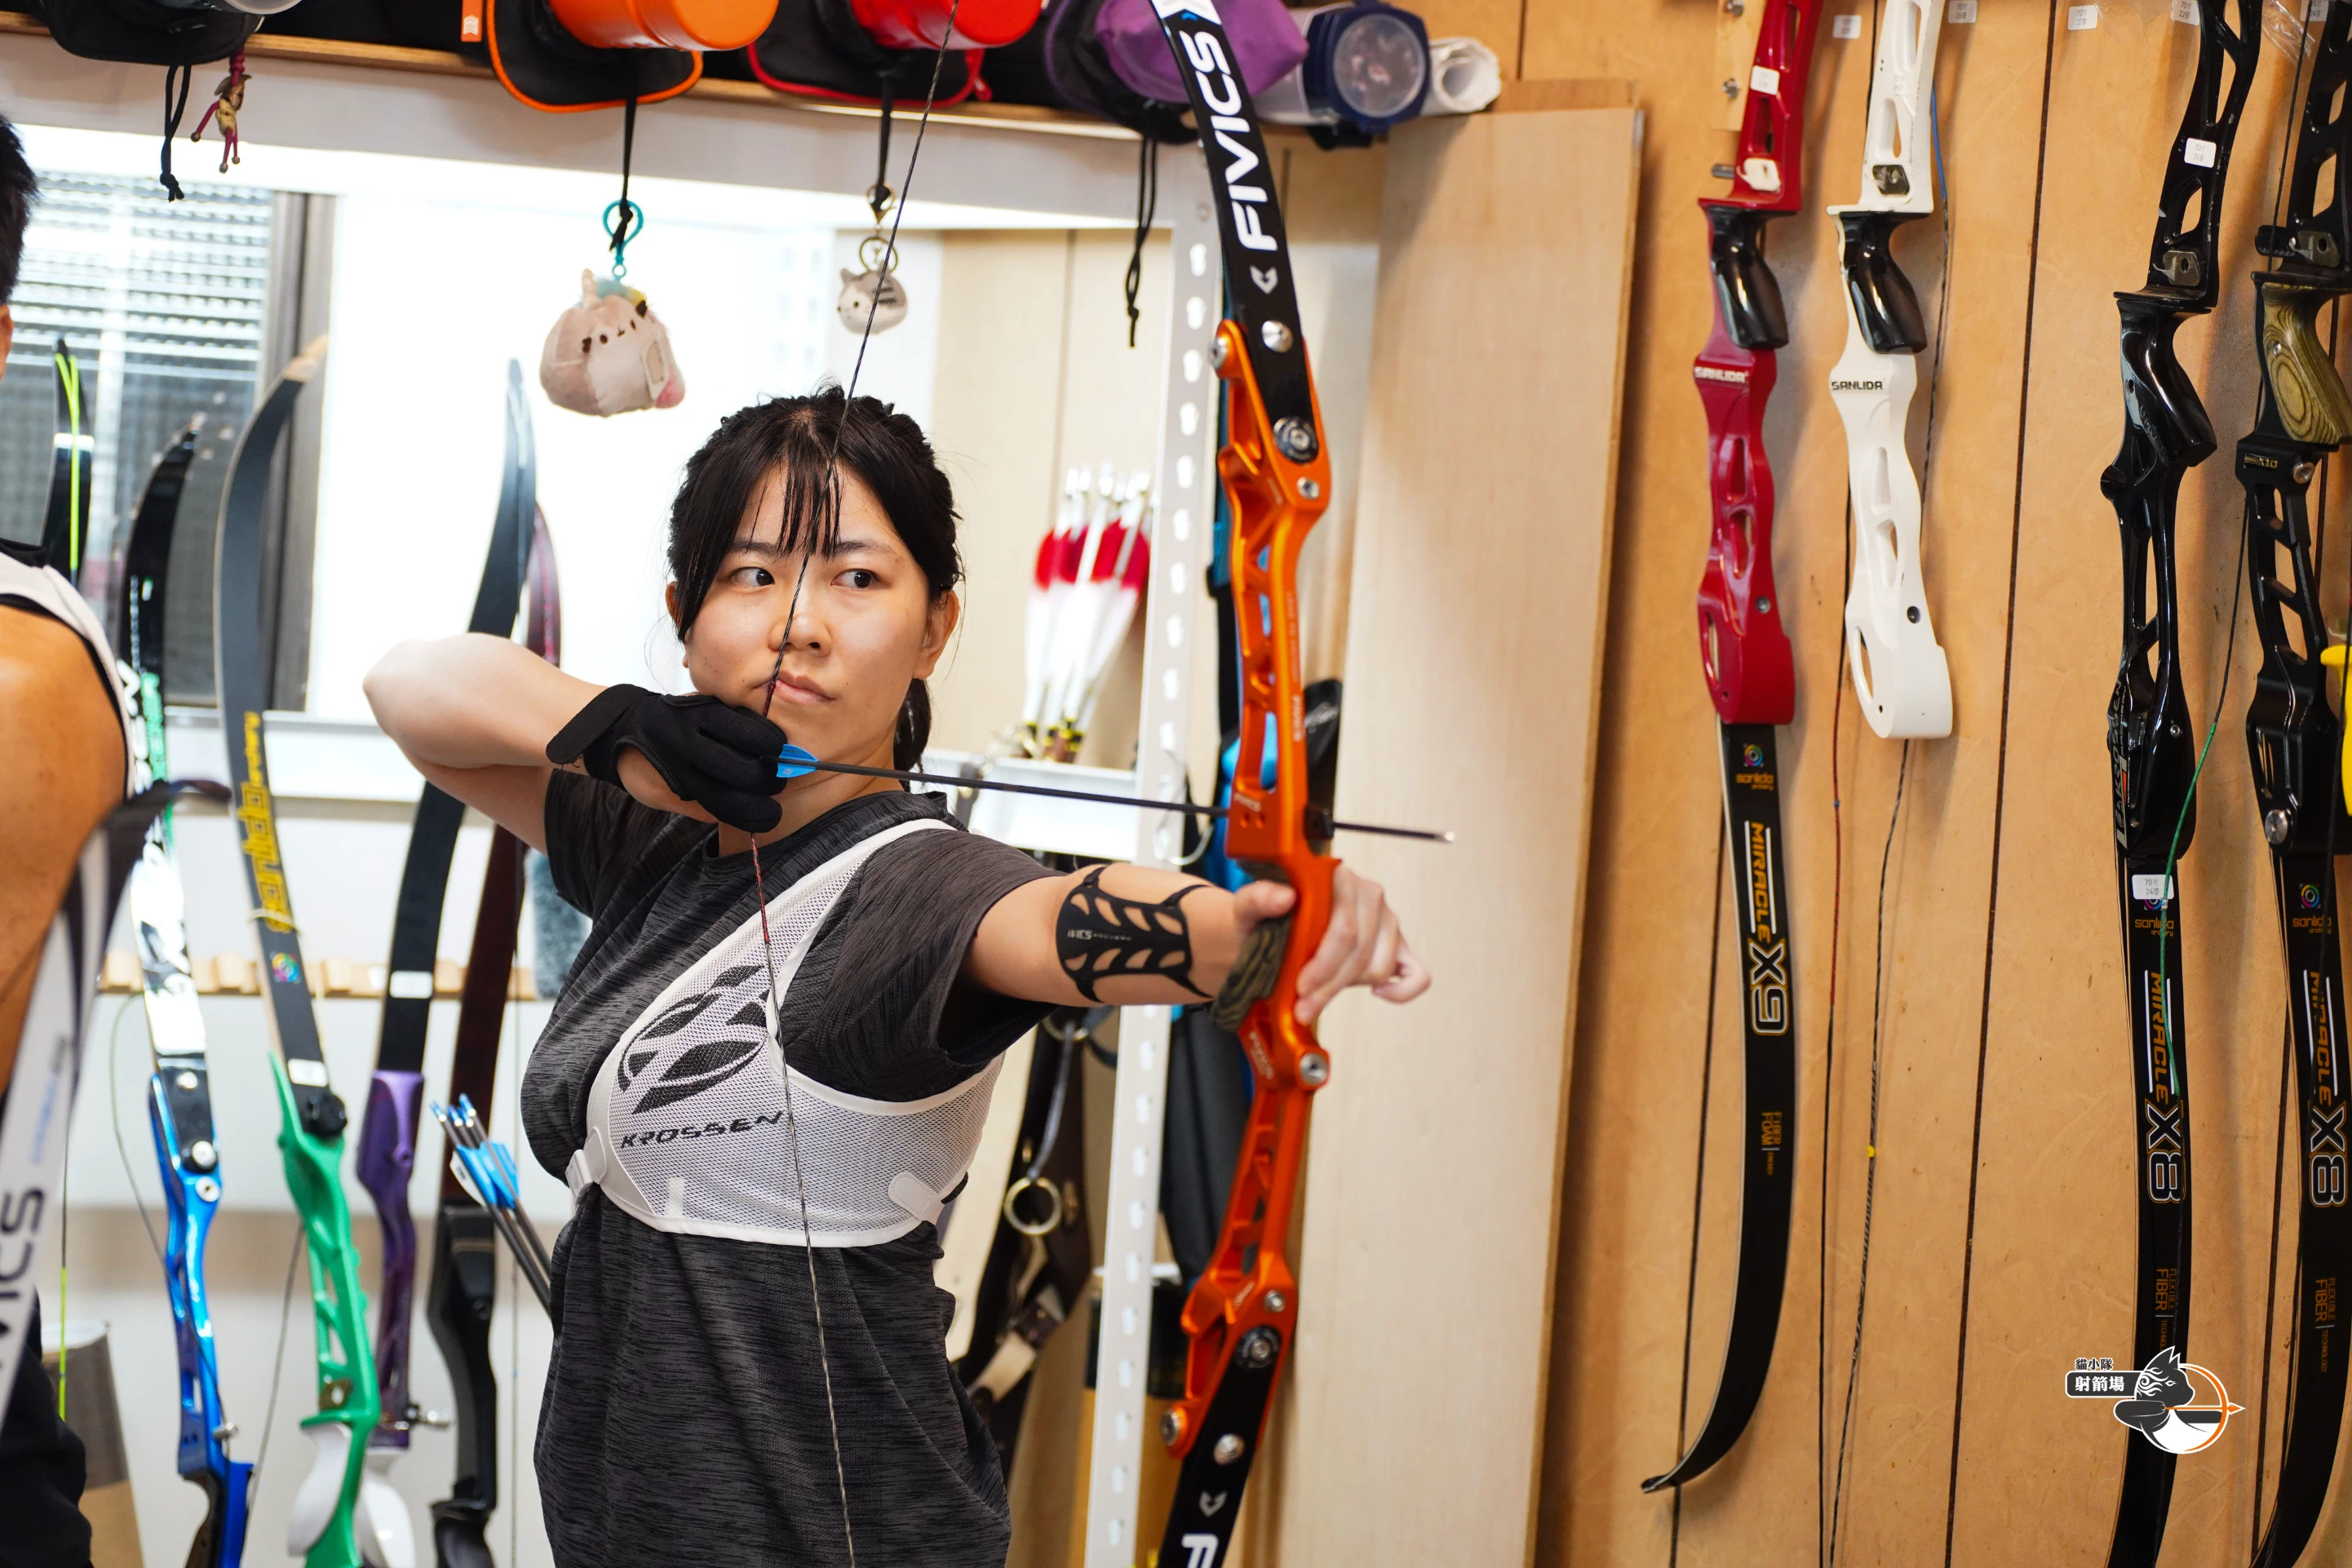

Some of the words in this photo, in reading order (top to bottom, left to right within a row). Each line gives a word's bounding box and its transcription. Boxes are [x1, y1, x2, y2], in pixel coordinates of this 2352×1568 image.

[1179, 30, 1278, 251] FIVICS
[1694, 366, 1748, 383] SANLIDA
[1831, 380, 1884, 391] SANLIDA
[1751, 822, 1771, 944] MIRACLE
[2134, 917, 2174, 929] sanlia
[1747, 938, 1789, 1035] X9
[2150, 972, 2169, 1105] MIRACLE
[620, 1110, 783, 1149] KROSSEN
[2145, 1098, 2186, 1203] X8
[2308, 1100, 2348, 1207] X8
[2155, 1269, 2168, 1311] FIBER
[2315, 1278, 2328, 1322] FIBER
[2328, 1278, 2336, 1321] FLEXIBLE
